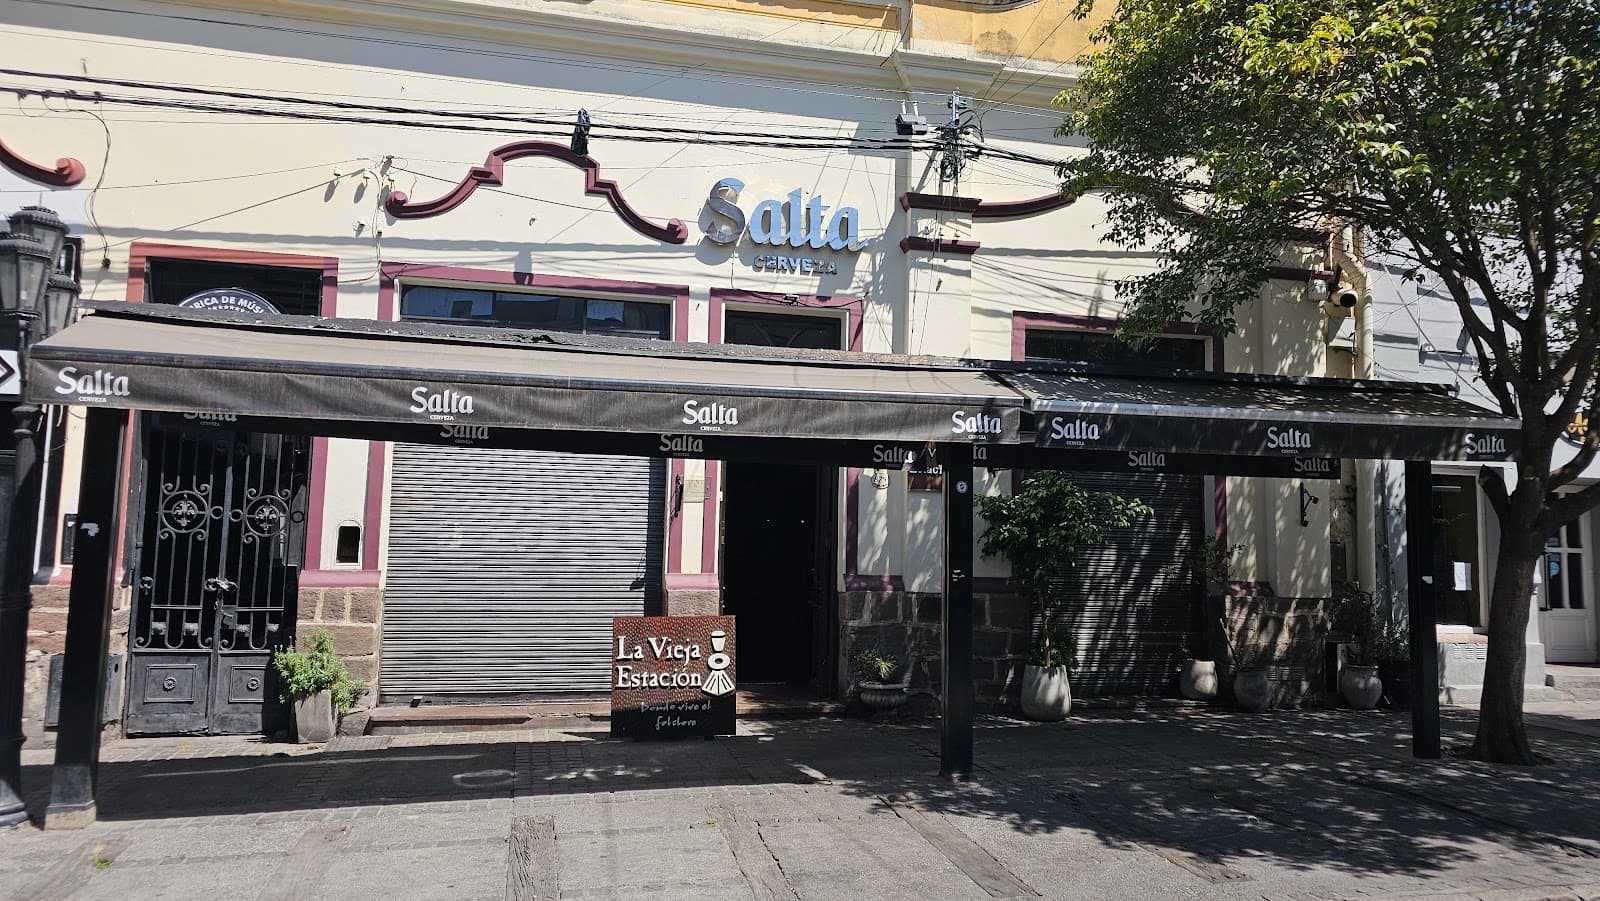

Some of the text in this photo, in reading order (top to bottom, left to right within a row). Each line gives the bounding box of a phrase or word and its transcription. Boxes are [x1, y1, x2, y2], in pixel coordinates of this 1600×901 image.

[699, 177, 868, 251] Salta
[754, 255, 838, 274] CERVEZA
[190, 297, 219, 309] RICA
[221, 296, 236, 304] DE
[55, 366, 130, 396] Salta
[409, 386, 474, 414] Salta
[682, 400, 739, 425] Salta
[951, 411, 1002, 434] Salta
[1051, 416, 1100, 440] Salta
[1267, 426, 1312, 448] Salta
[659, 433, 703, 453] Salta
[873, 444, 917, 464] Salta
[1465, 433, 1506, 454] Salta
[1128, 450, 1166, 467] Salta
[1294, 456, 1331, 473] Salta
[616, 635, 701, 667] La Vieja
[616, 665, 702, 688] Estación
[641, 700, 711, 713] Donde vive el
